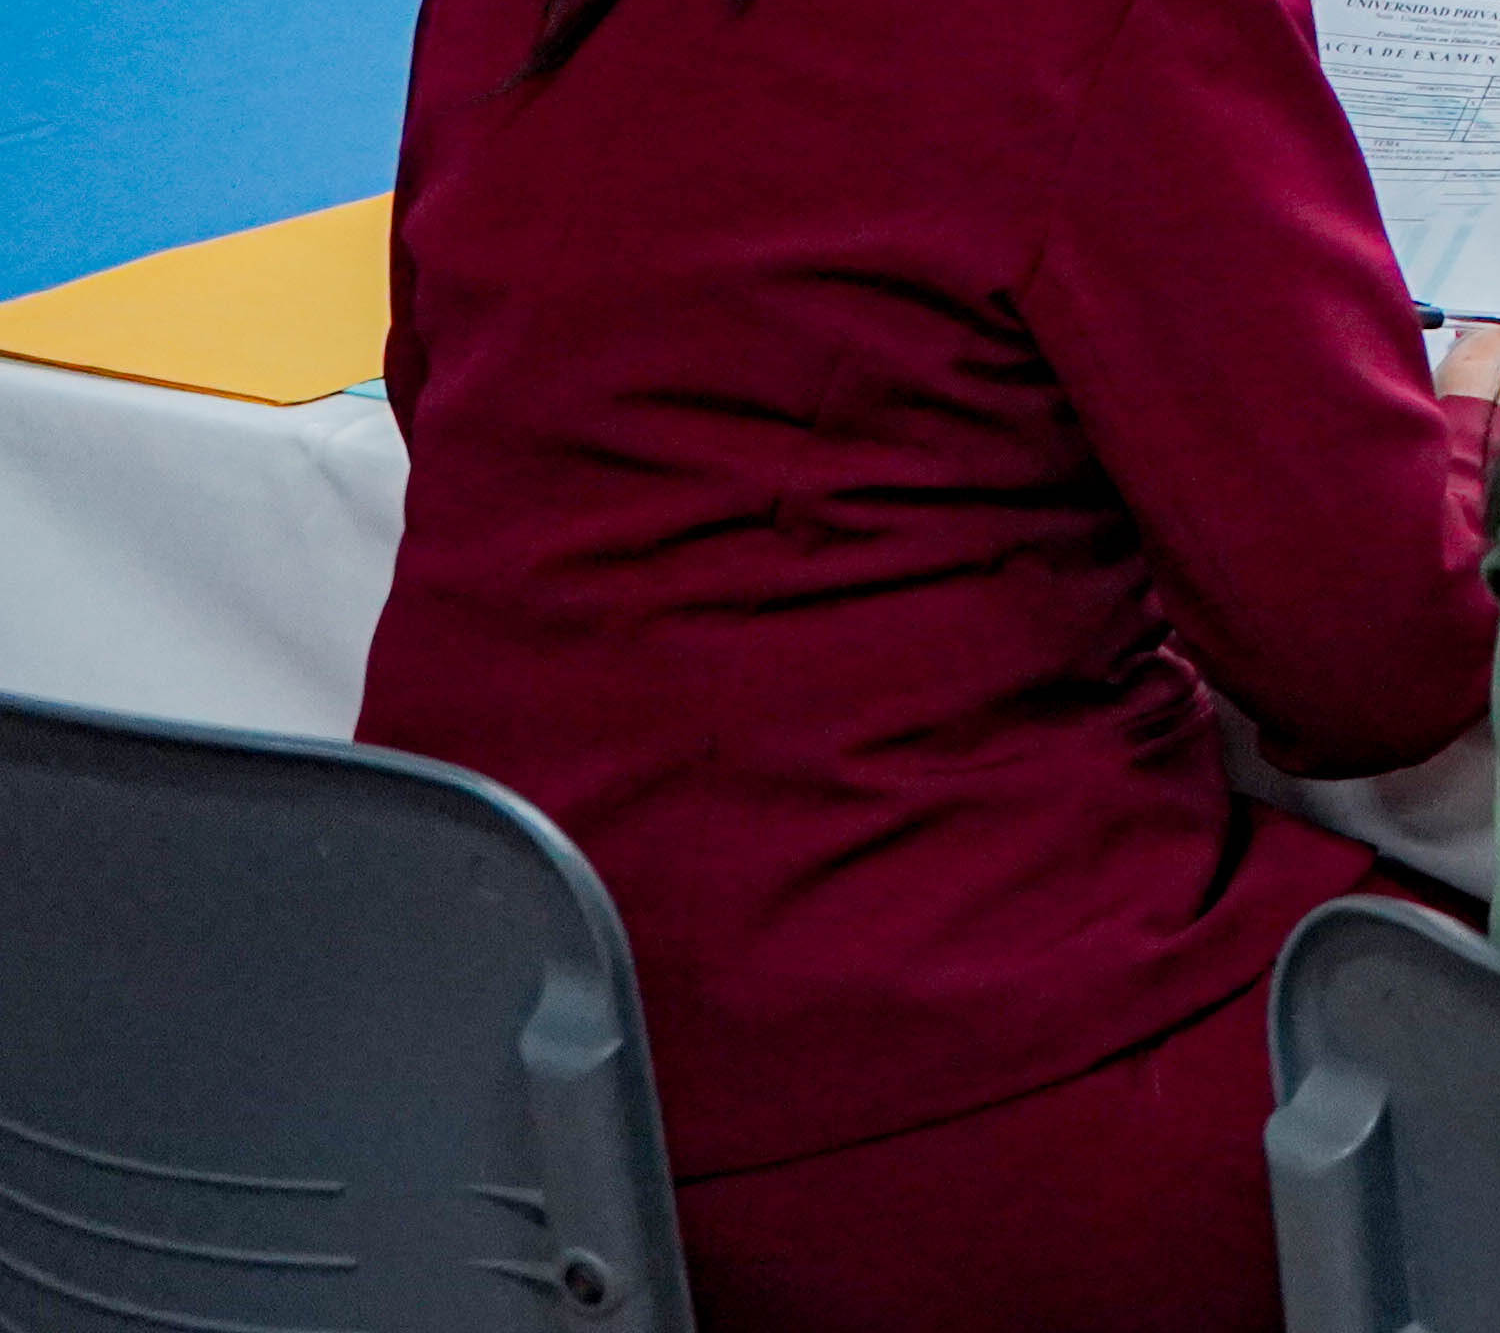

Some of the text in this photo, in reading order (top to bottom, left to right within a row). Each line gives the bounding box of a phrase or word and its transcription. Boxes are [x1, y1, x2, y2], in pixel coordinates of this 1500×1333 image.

[1324, 42, 1497, 65] ACTA DE EXAMEN
